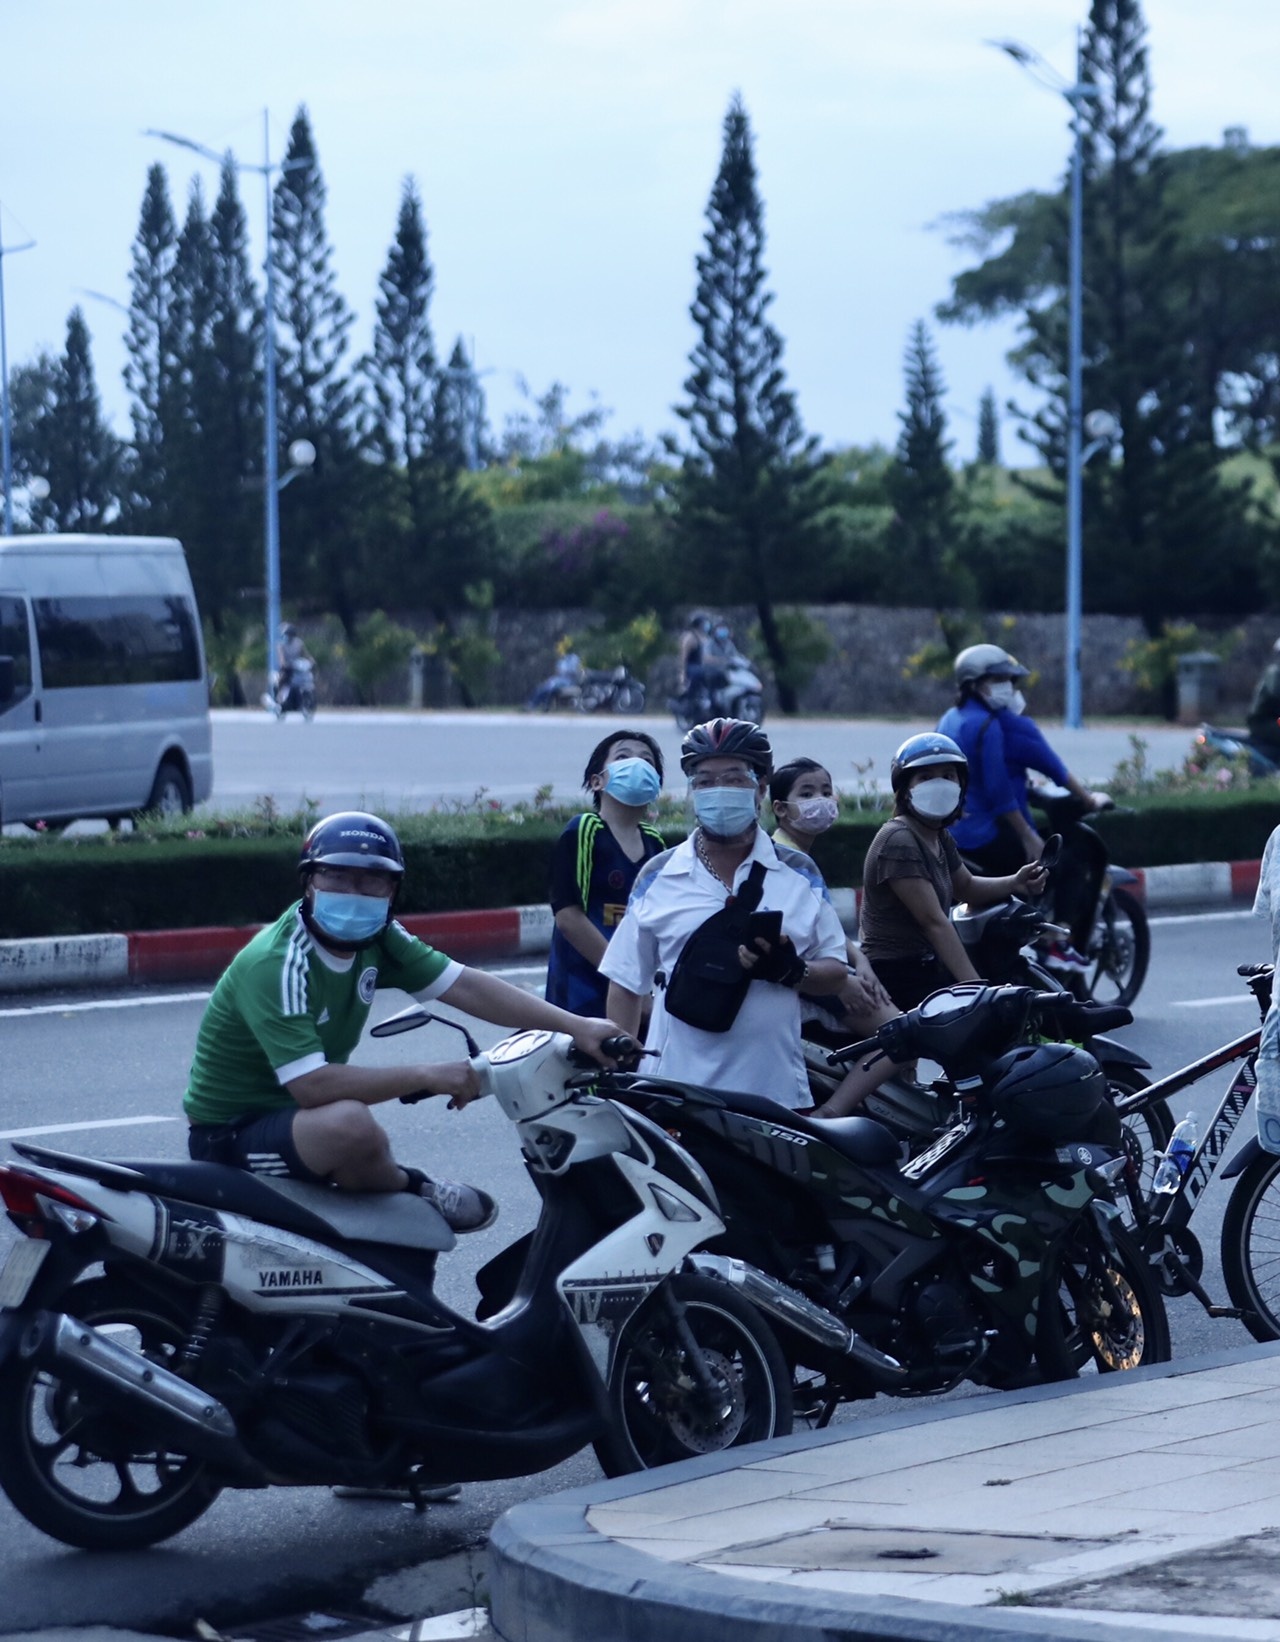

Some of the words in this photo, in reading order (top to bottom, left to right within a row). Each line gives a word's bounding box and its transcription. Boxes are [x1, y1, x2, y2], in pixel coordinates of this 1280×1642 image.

[340, 829, 387, 843] HONDA
[770, 1128, 809, 1146] 150
[259, 1270, 323, 1287] YAMAHA
